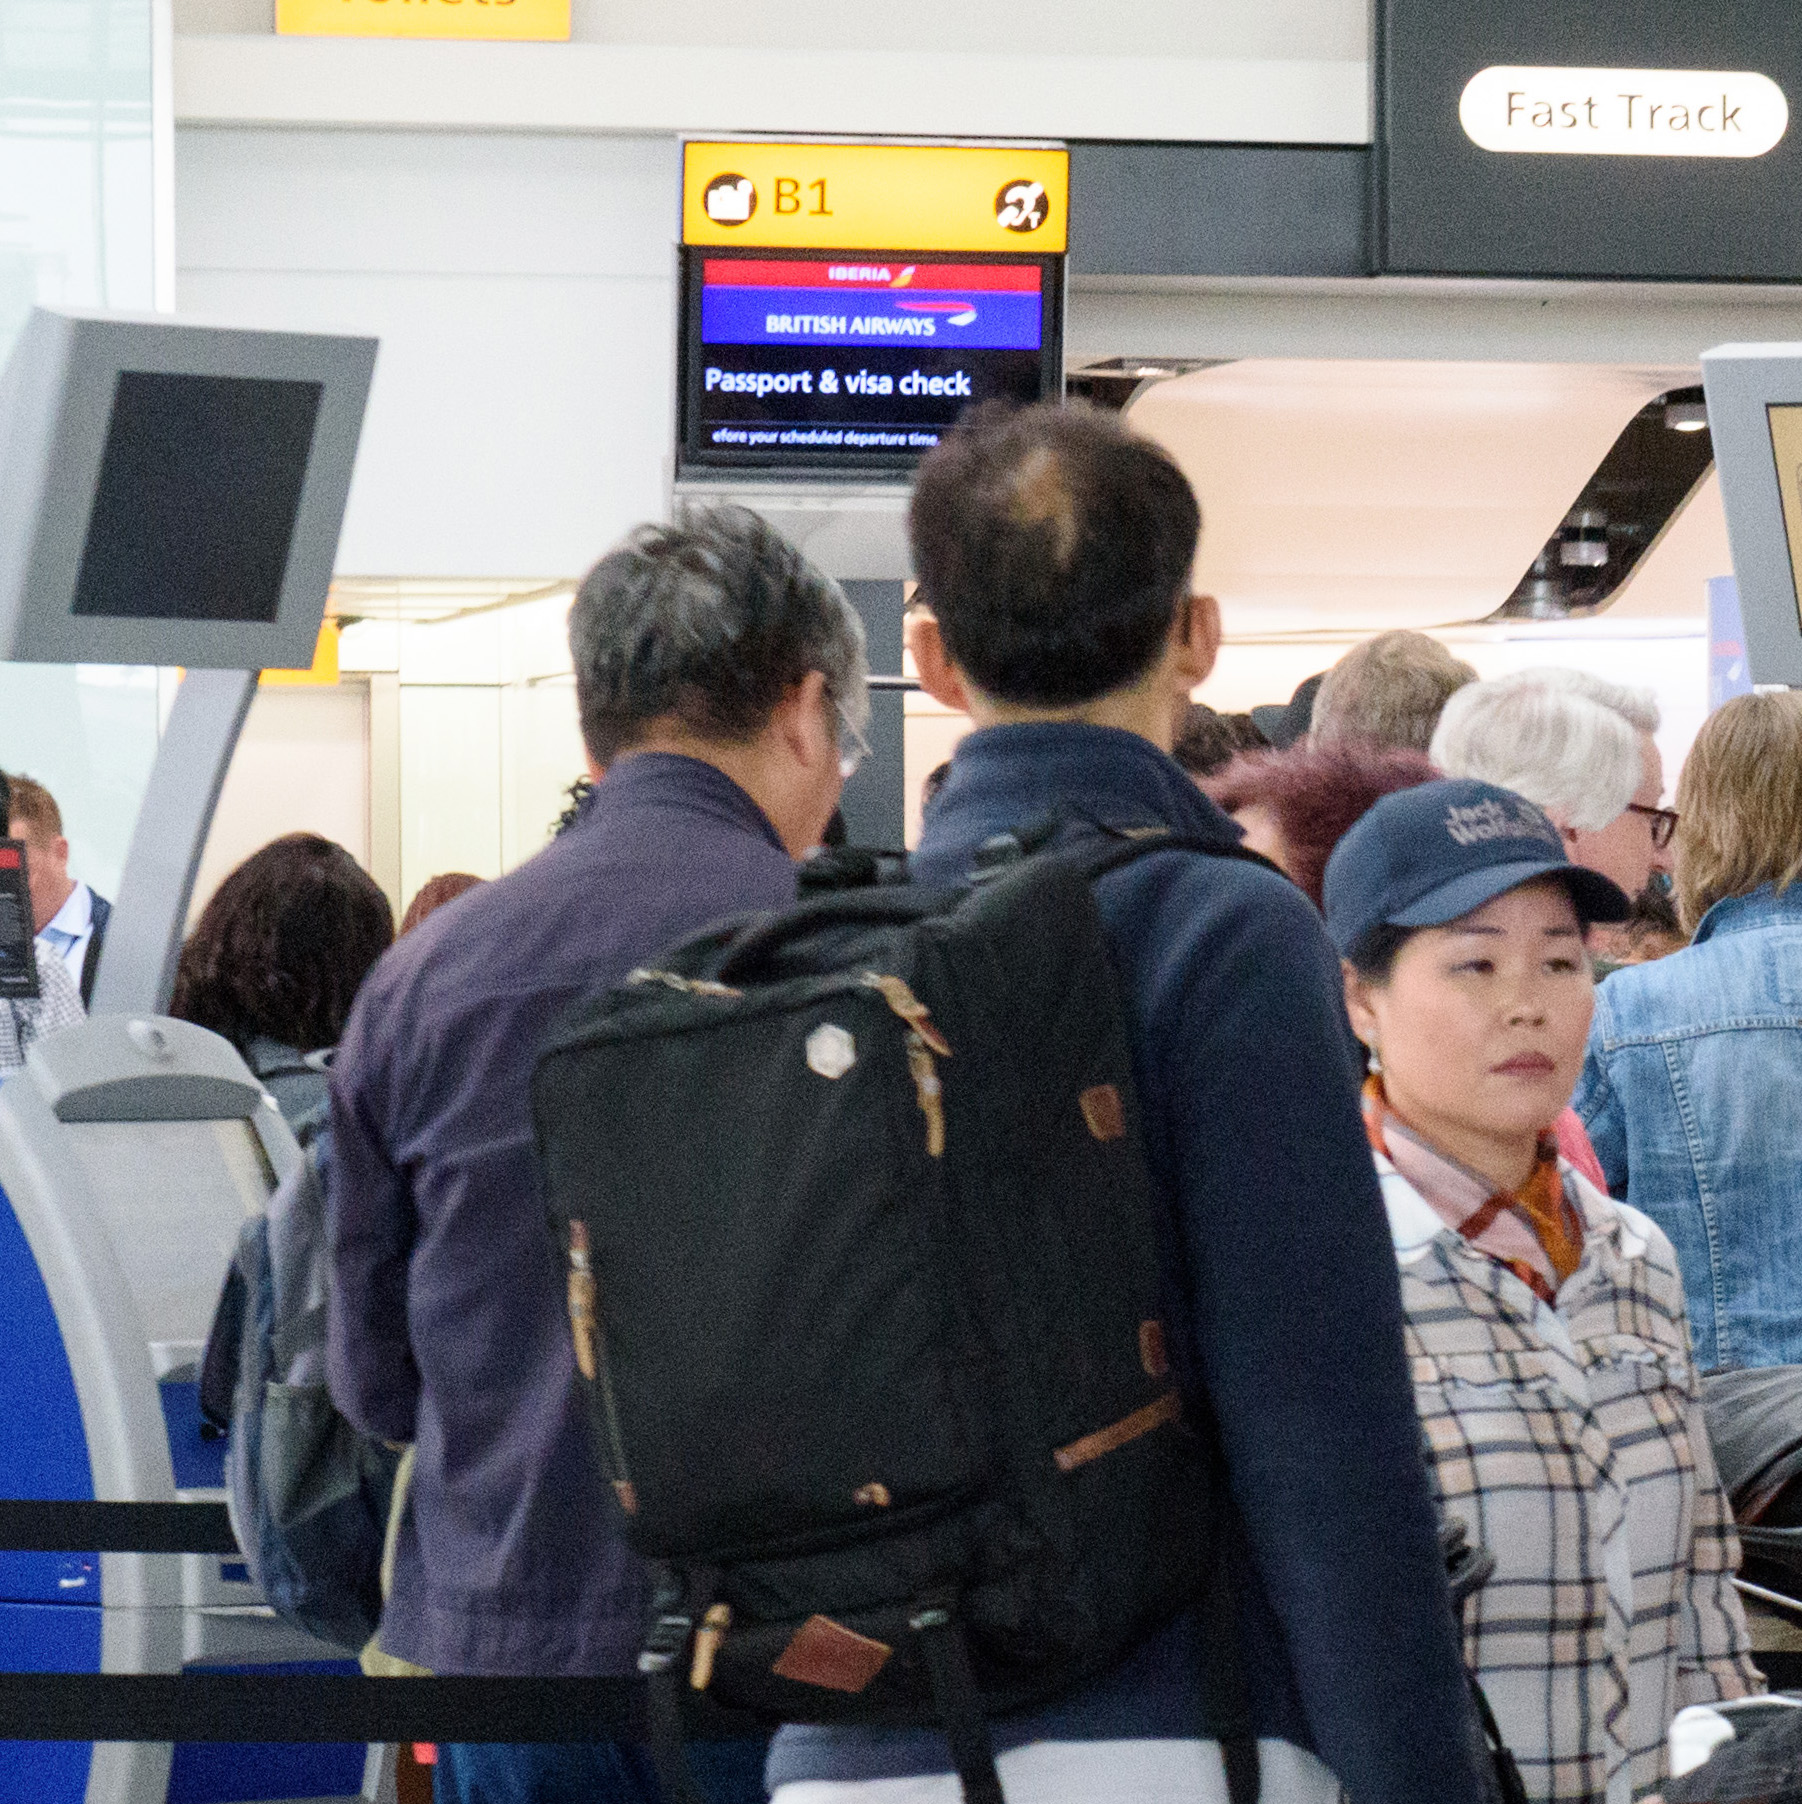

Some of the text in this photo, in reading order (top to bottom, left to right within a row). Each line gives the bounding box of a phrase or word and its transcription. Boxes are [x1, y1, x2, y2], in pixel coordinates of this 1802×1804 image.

[1507, 91, 1742, 133] Fast Track
[773, 176, 834, 217] B1
[828, 265, 891, 282] IBERIA
[765, 314, 936, 337] BRITISH AIRWAYS
[704, 367, 972, 398] Passport & visa check
[779, 429, 843, 445] scheduled
[844, 431, 907, 447] departure
